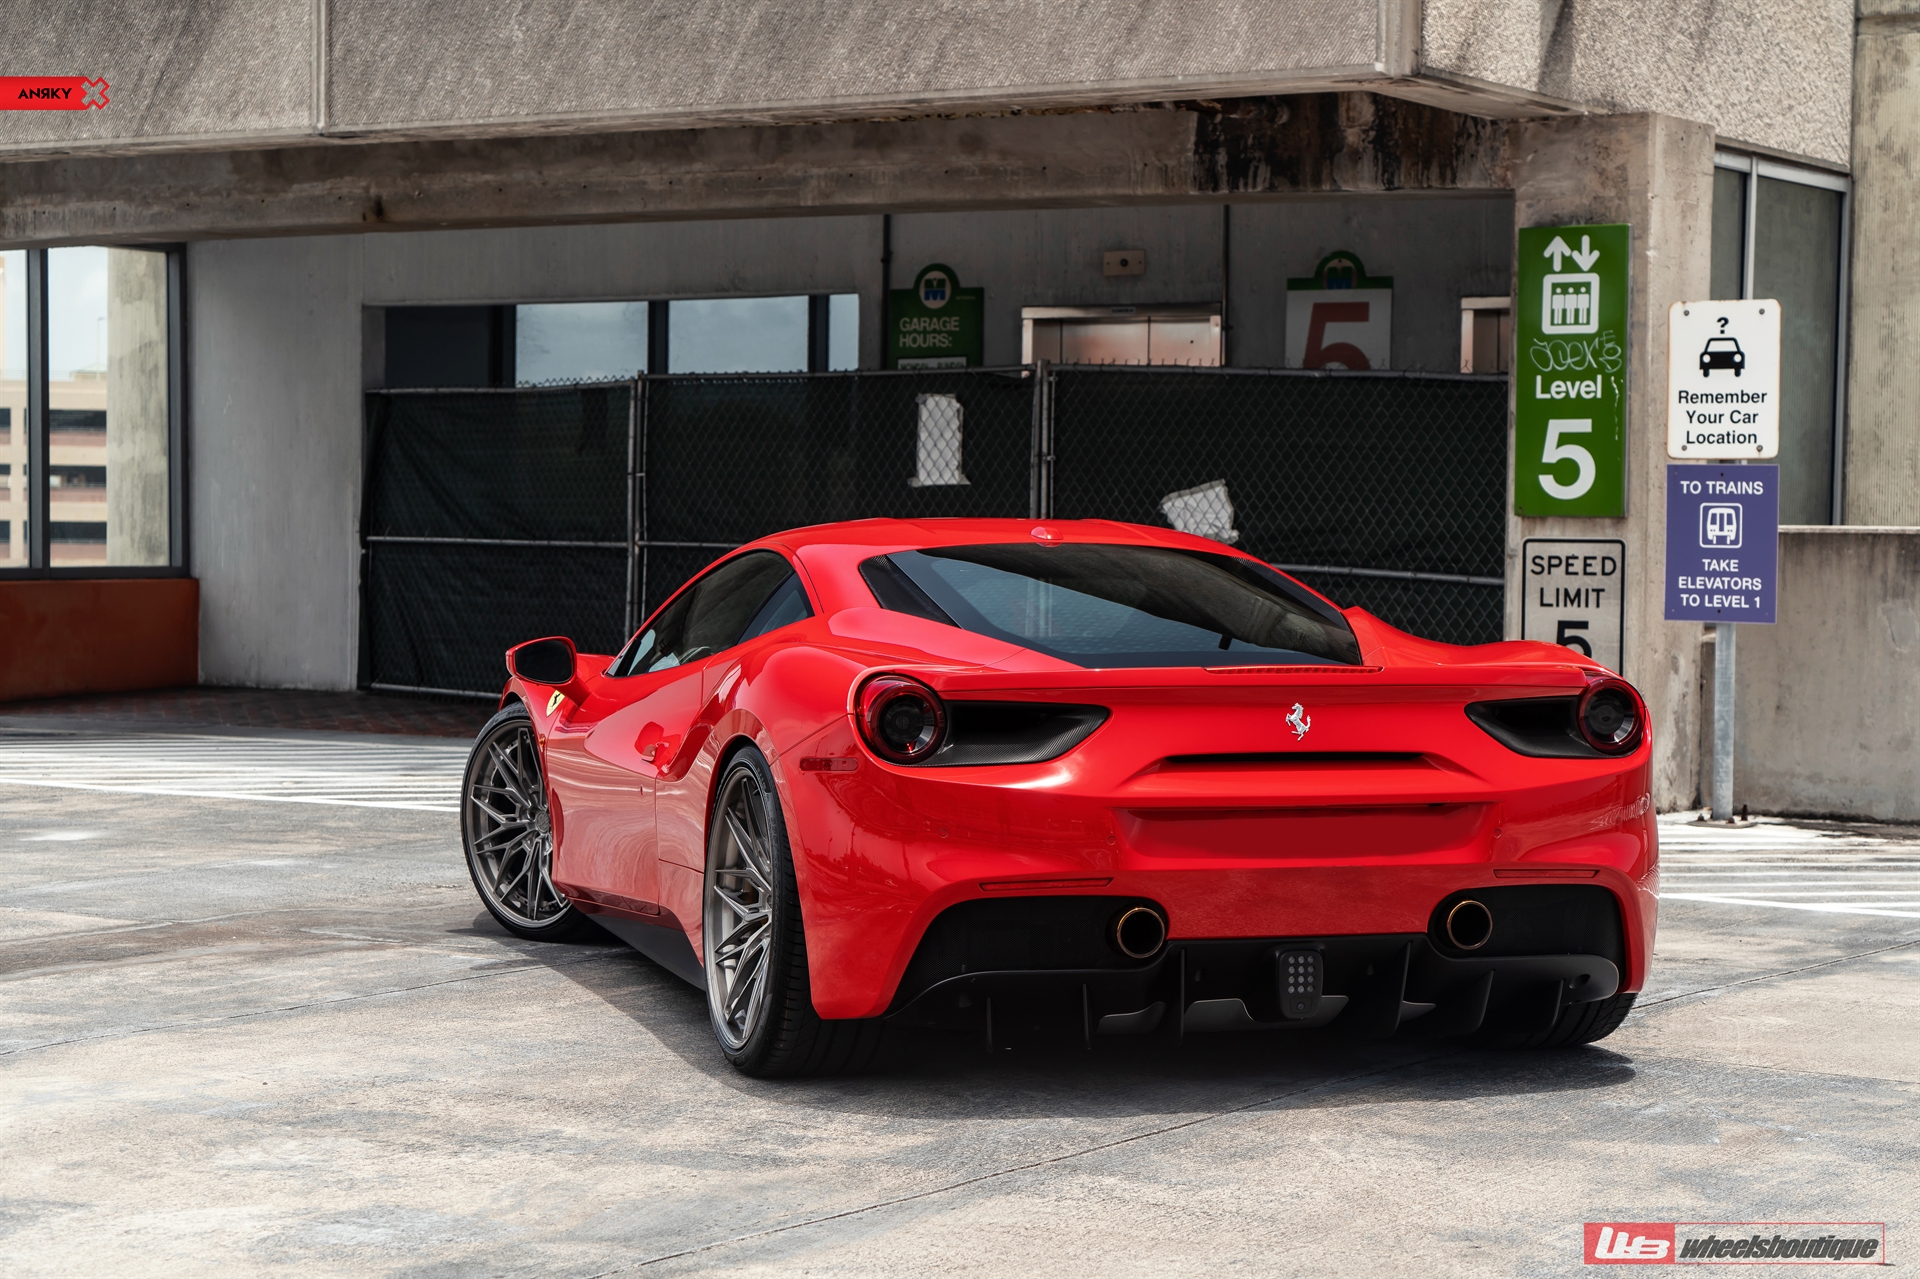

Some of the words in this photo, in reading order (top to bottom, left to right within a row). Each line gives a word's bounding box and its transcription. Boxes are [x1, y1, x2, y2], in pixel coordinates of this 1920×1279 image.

[899, 316, 960, 332] GARAGE
[899, 333, 953, 348] HOURS:
[1303, 301, 1370, 370] 5
[1535, 374, 1602, 399] Level
[1678, 389, 1768, 404] Remember
[1686, 410, 1725, 424] Your
[1729, 409, 1759, 424] Car
[1686, 430, 1758, 444] Location
[1538, 418, 1596, 500] 5
[1680, 481, 1702, 495] TO
[1706, 481, 1764, 495] TRAINS
[1530, 555, 1617, 576] SPEED
[1702, 559, 1739, 572] TAKE
[1678, 576, 1762, 591] ELEVATORS
[1540, 587, 1605, 608] LIMIT
[1680, 594, 1700, 607] TO
[1705, 595, 1749, 608] LEVEL
[1754, 596, 1761, 608] 1
